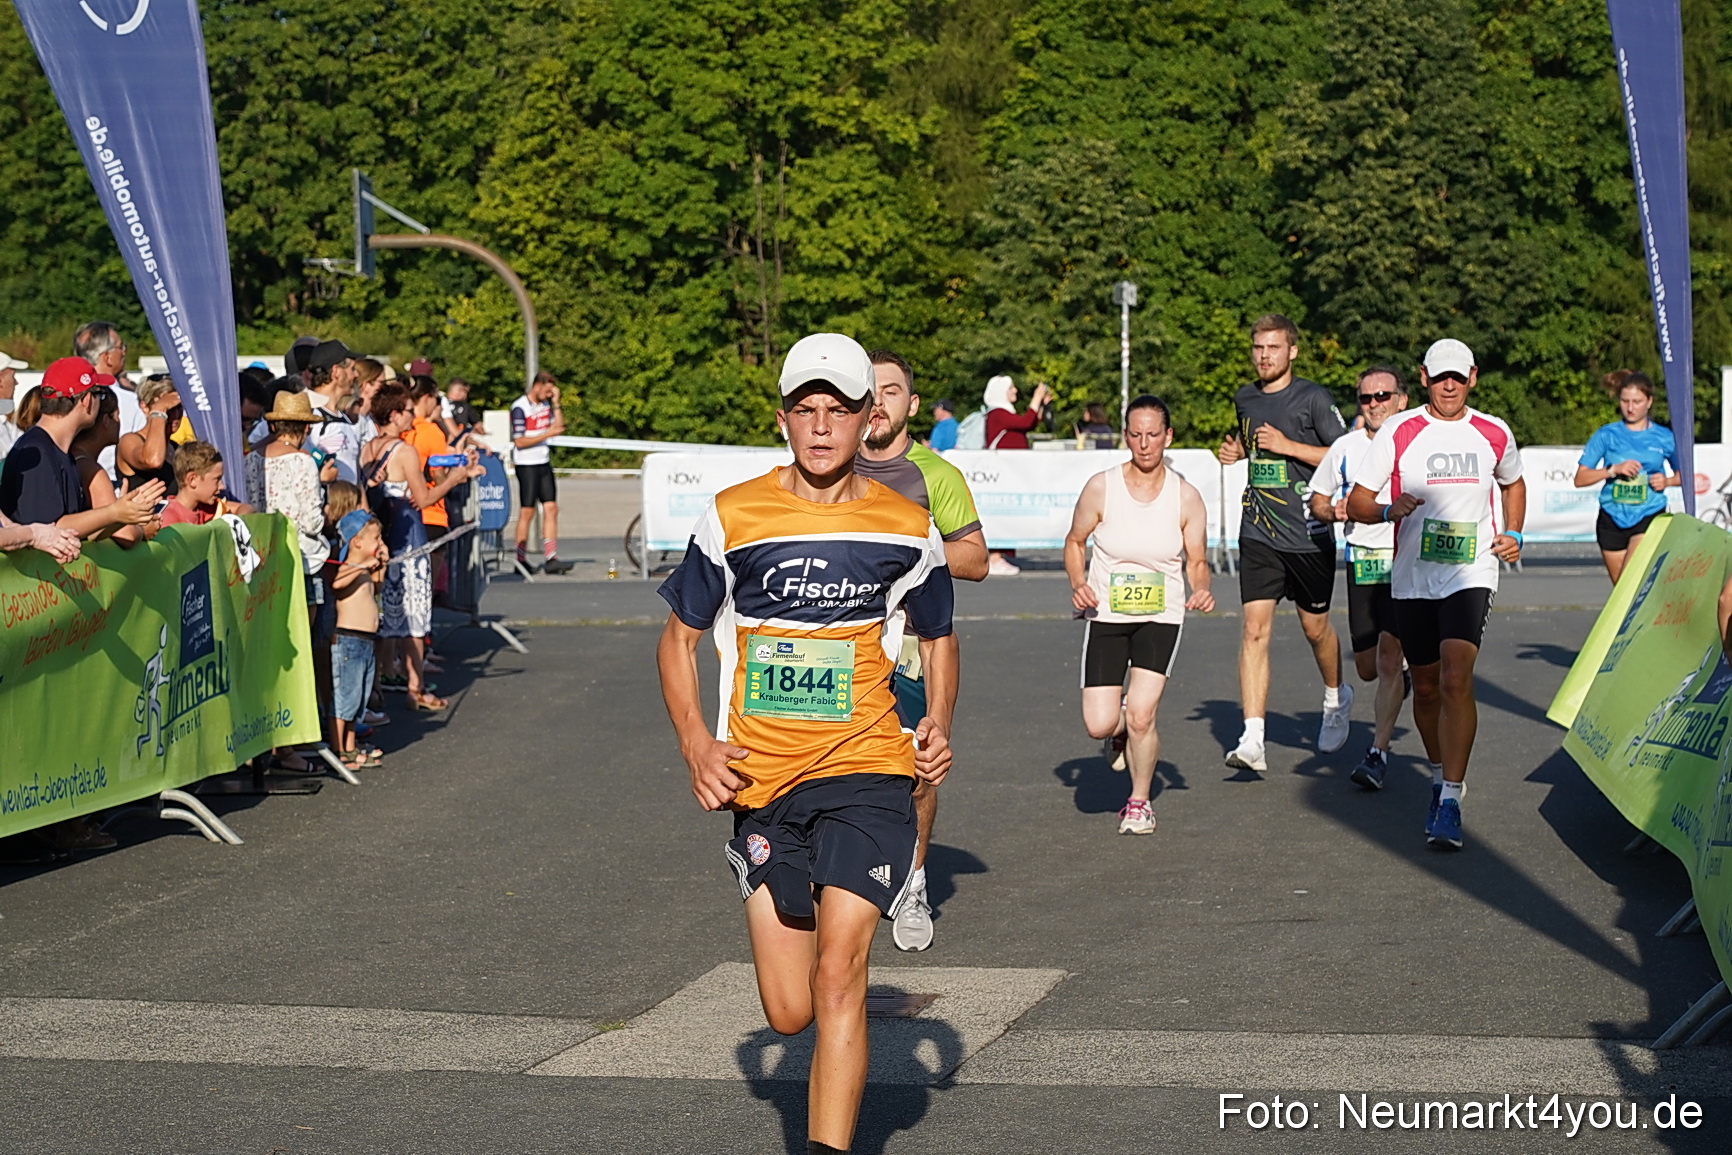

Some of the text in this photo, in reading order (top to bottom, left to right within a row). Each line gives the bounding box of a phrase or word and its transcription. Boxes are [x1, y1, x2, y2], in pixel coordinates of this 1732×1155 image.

[1254, 463, 1275, 476] 855
[1426, 452, 1479, 473] OM
[668, 472, 703, 485] NOW
[966, 471, 1000, 483] NOW
[1435, 535, 1466, 550] 507
[0, 562, 101, 630] Gesunde Firmen
[782, 577, 882, 599] Fischer
[1123, 586, 1153, 601] 257
[750, 671, 761, 700] RUN
[763, 664, 836, 695] 1844
[759, 692, 837, 706] Krauberger Fabio
[836, 673, 849, 711] 2022
[868, 869, 892, 890] adidas
